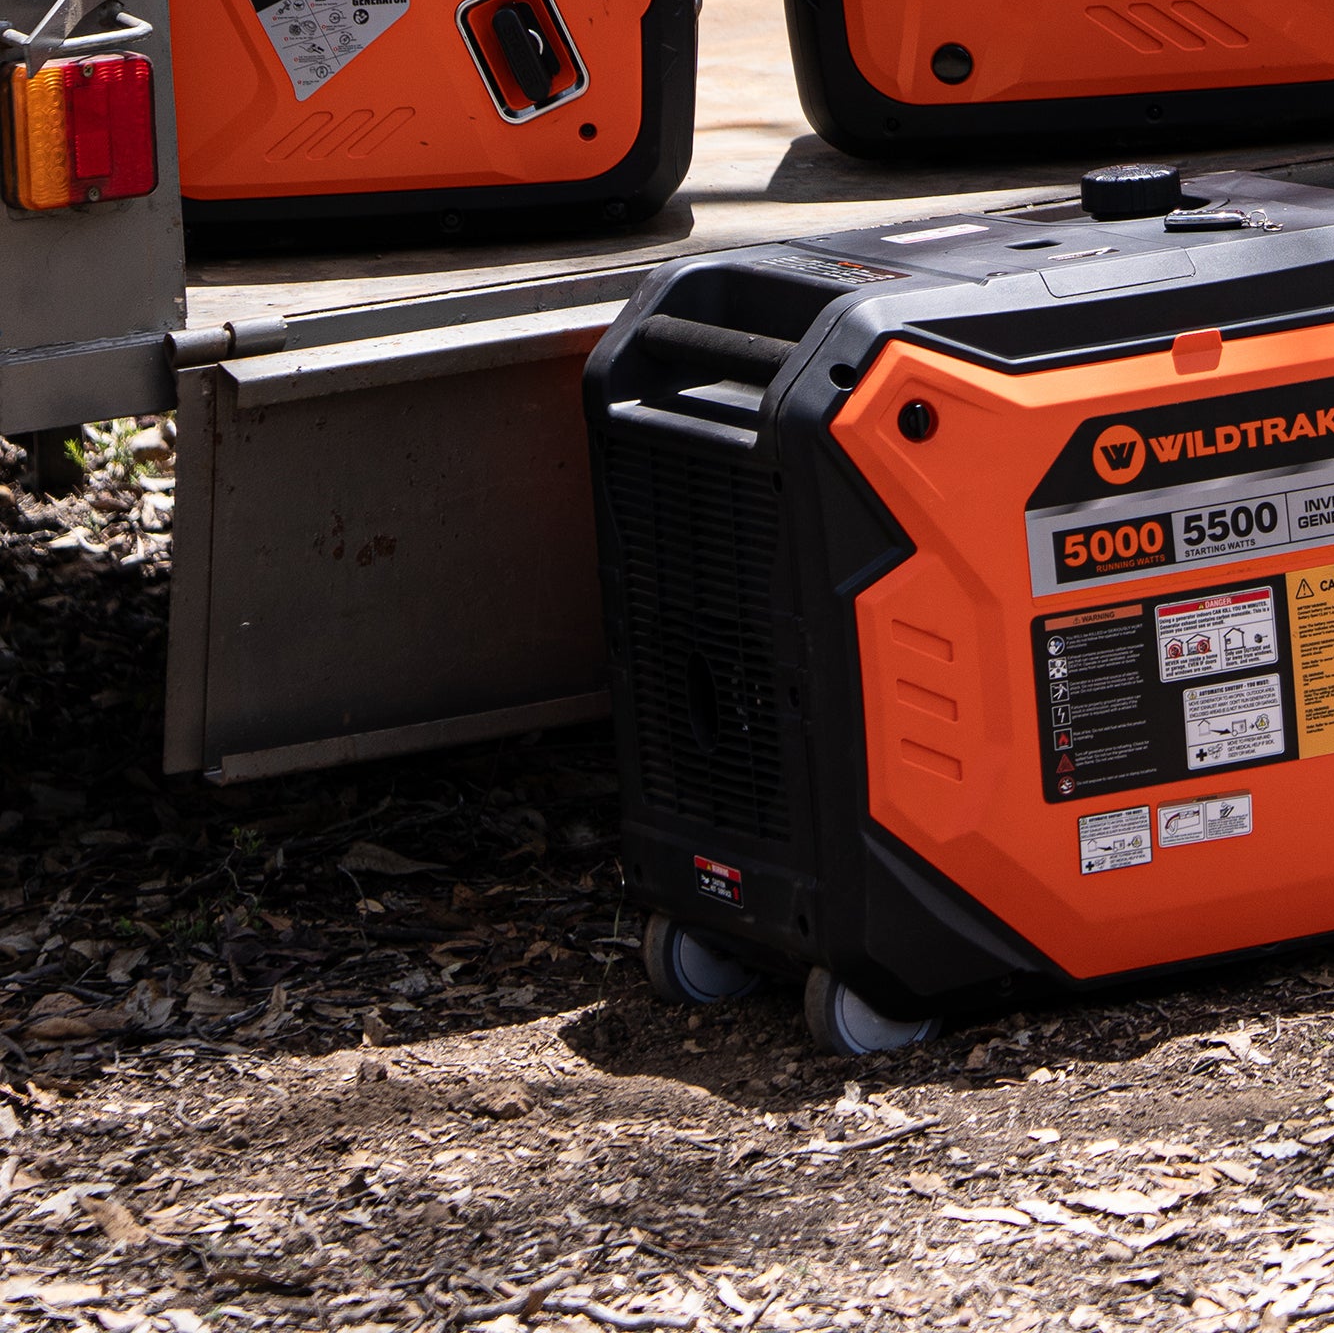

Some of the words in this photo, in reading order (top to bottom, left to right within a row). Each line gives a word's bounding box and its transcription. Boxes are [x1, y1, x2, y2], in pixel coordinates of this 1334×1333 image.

[1063, 522, 1164, 567] 5000
[1182, 502, 1278, 547] 5500
[1184, 544, 1227, 558] STARTING
[1228, 538, 1256, 551] WATTS
[1096, 559, 1135, 573] RUNNING
[1137, 554, 1166, 566] WATTS
[1205, 598, 1232, 609] DANGER
[1081, 611, 1115, 622] WARNING
[1159, 622, 1180, 630] Generator
[1199, 687, 1224, 696] AUTOMATIC
